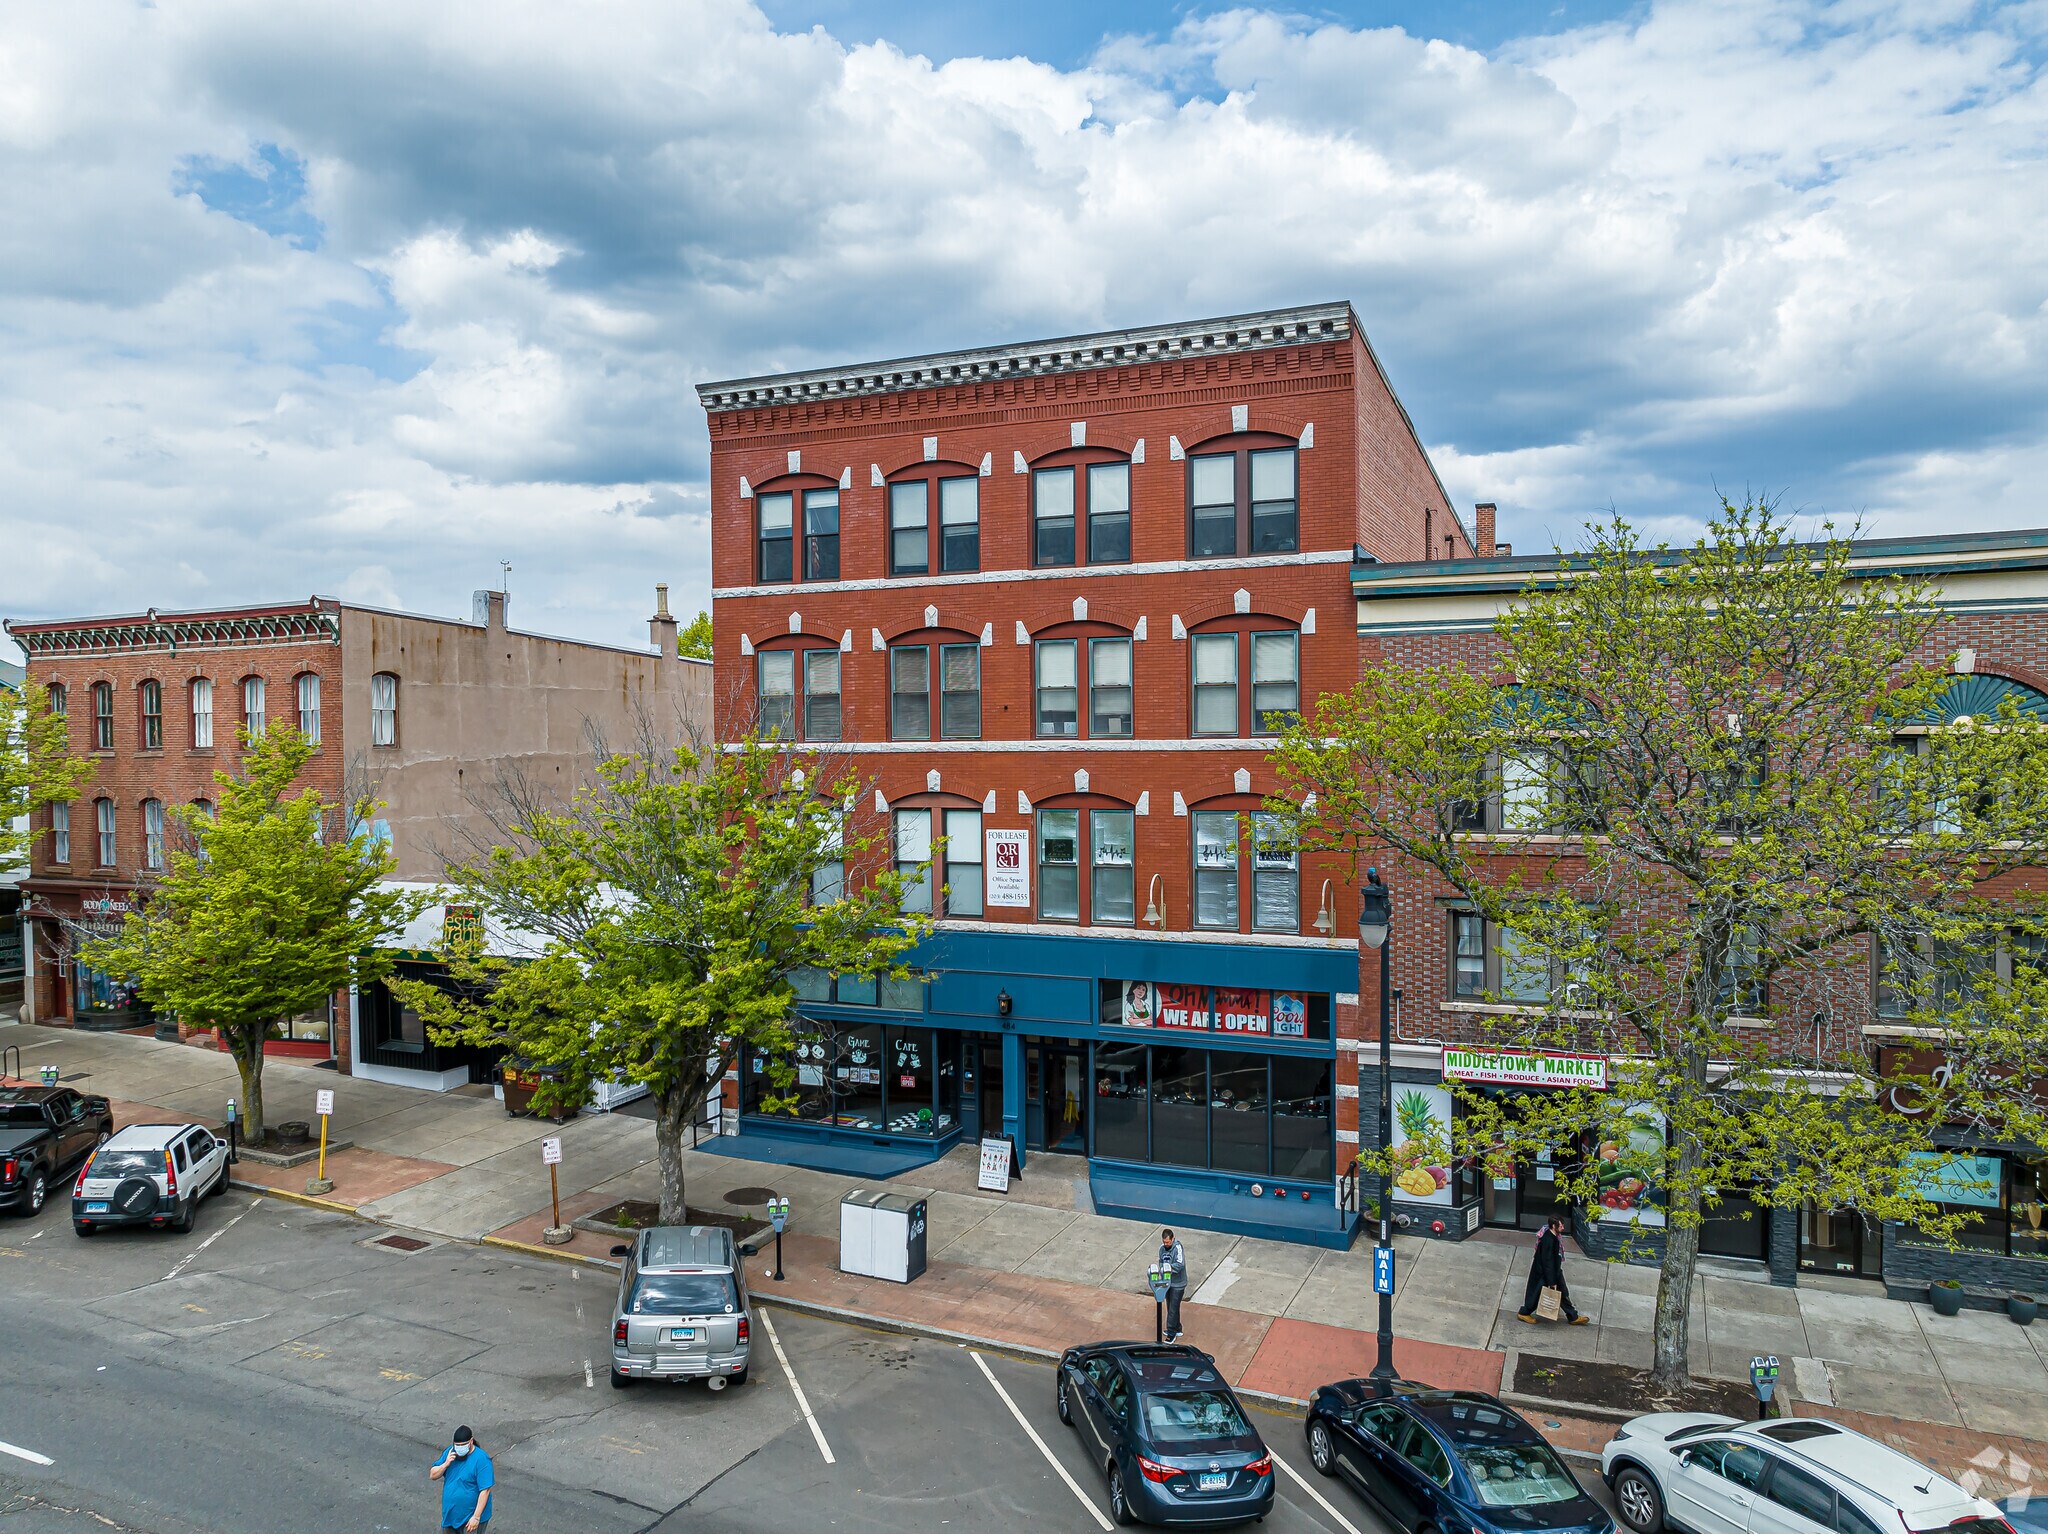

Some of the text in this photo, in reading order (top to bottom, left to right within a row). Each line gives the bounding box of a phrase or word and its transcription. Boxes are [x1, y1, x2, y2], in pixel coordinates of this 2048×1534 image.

[988, 831, 1027, 840] FOR LEASE
[1002, 892, 1028, 900] 488-1555
[83, 900, 101, 911] BODY
[1163, 1008, 1188, 1026] WE
[1225, 1013, 1267, 1032] OPEN
[1273, 1005, 1304, 1024] Coors
[1276, 1023, 1302, 1033] IGHT
[1447, 1052, 1601, 1077] MIDDLETOWN MARKET
[1480, 1071, 1497, 1079] FISH
[1503, 1073, 1540, 1082] PRODUCE
[1546, 1076, 1571, 1084] ASIAN
[123, 1186, 146, 1208] HONDA
[1377, 1249, 1390, 1289] MAIN
